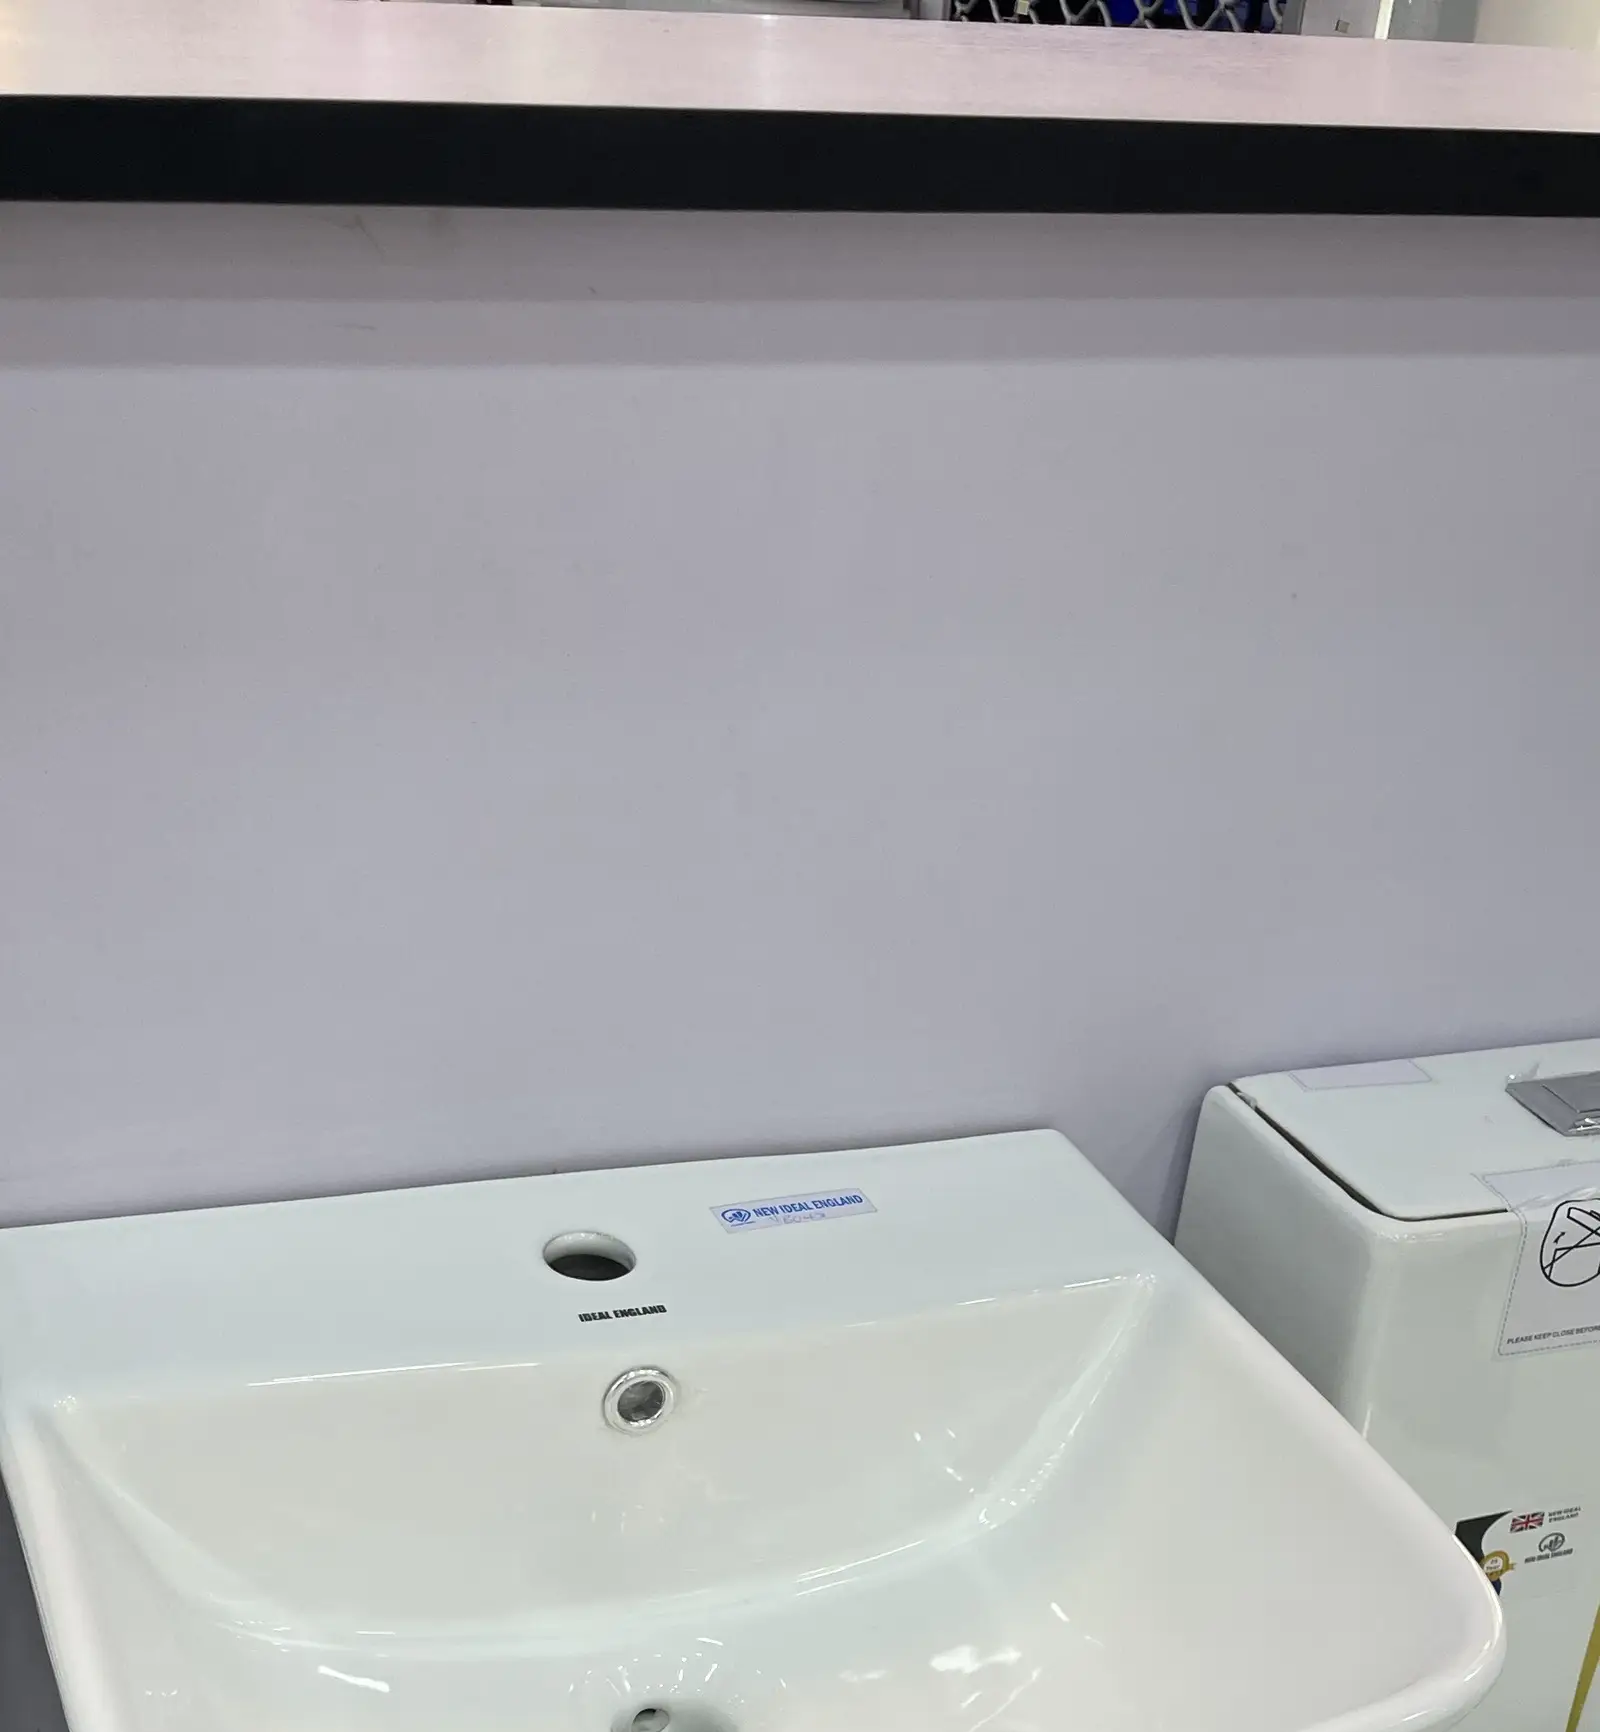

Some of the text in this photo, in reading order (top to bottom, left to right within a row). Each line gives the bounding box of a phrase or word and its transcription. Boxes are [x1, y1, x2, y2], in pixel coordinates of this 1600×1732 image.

[753, 1207, 778, 1218] NEW
[779, 1203, 811, 1214] IDEAL
[813, 1194, 863, 1209] ENGLAND
[578, 1304, 667, 1322] IDEAL ENGLAND
[1507, 1335, 1533, 1344] PLEASE
[1534, 1332, 1551, 1341] KEEP
[1552, 1329, 1574, 1338] CLOSE
